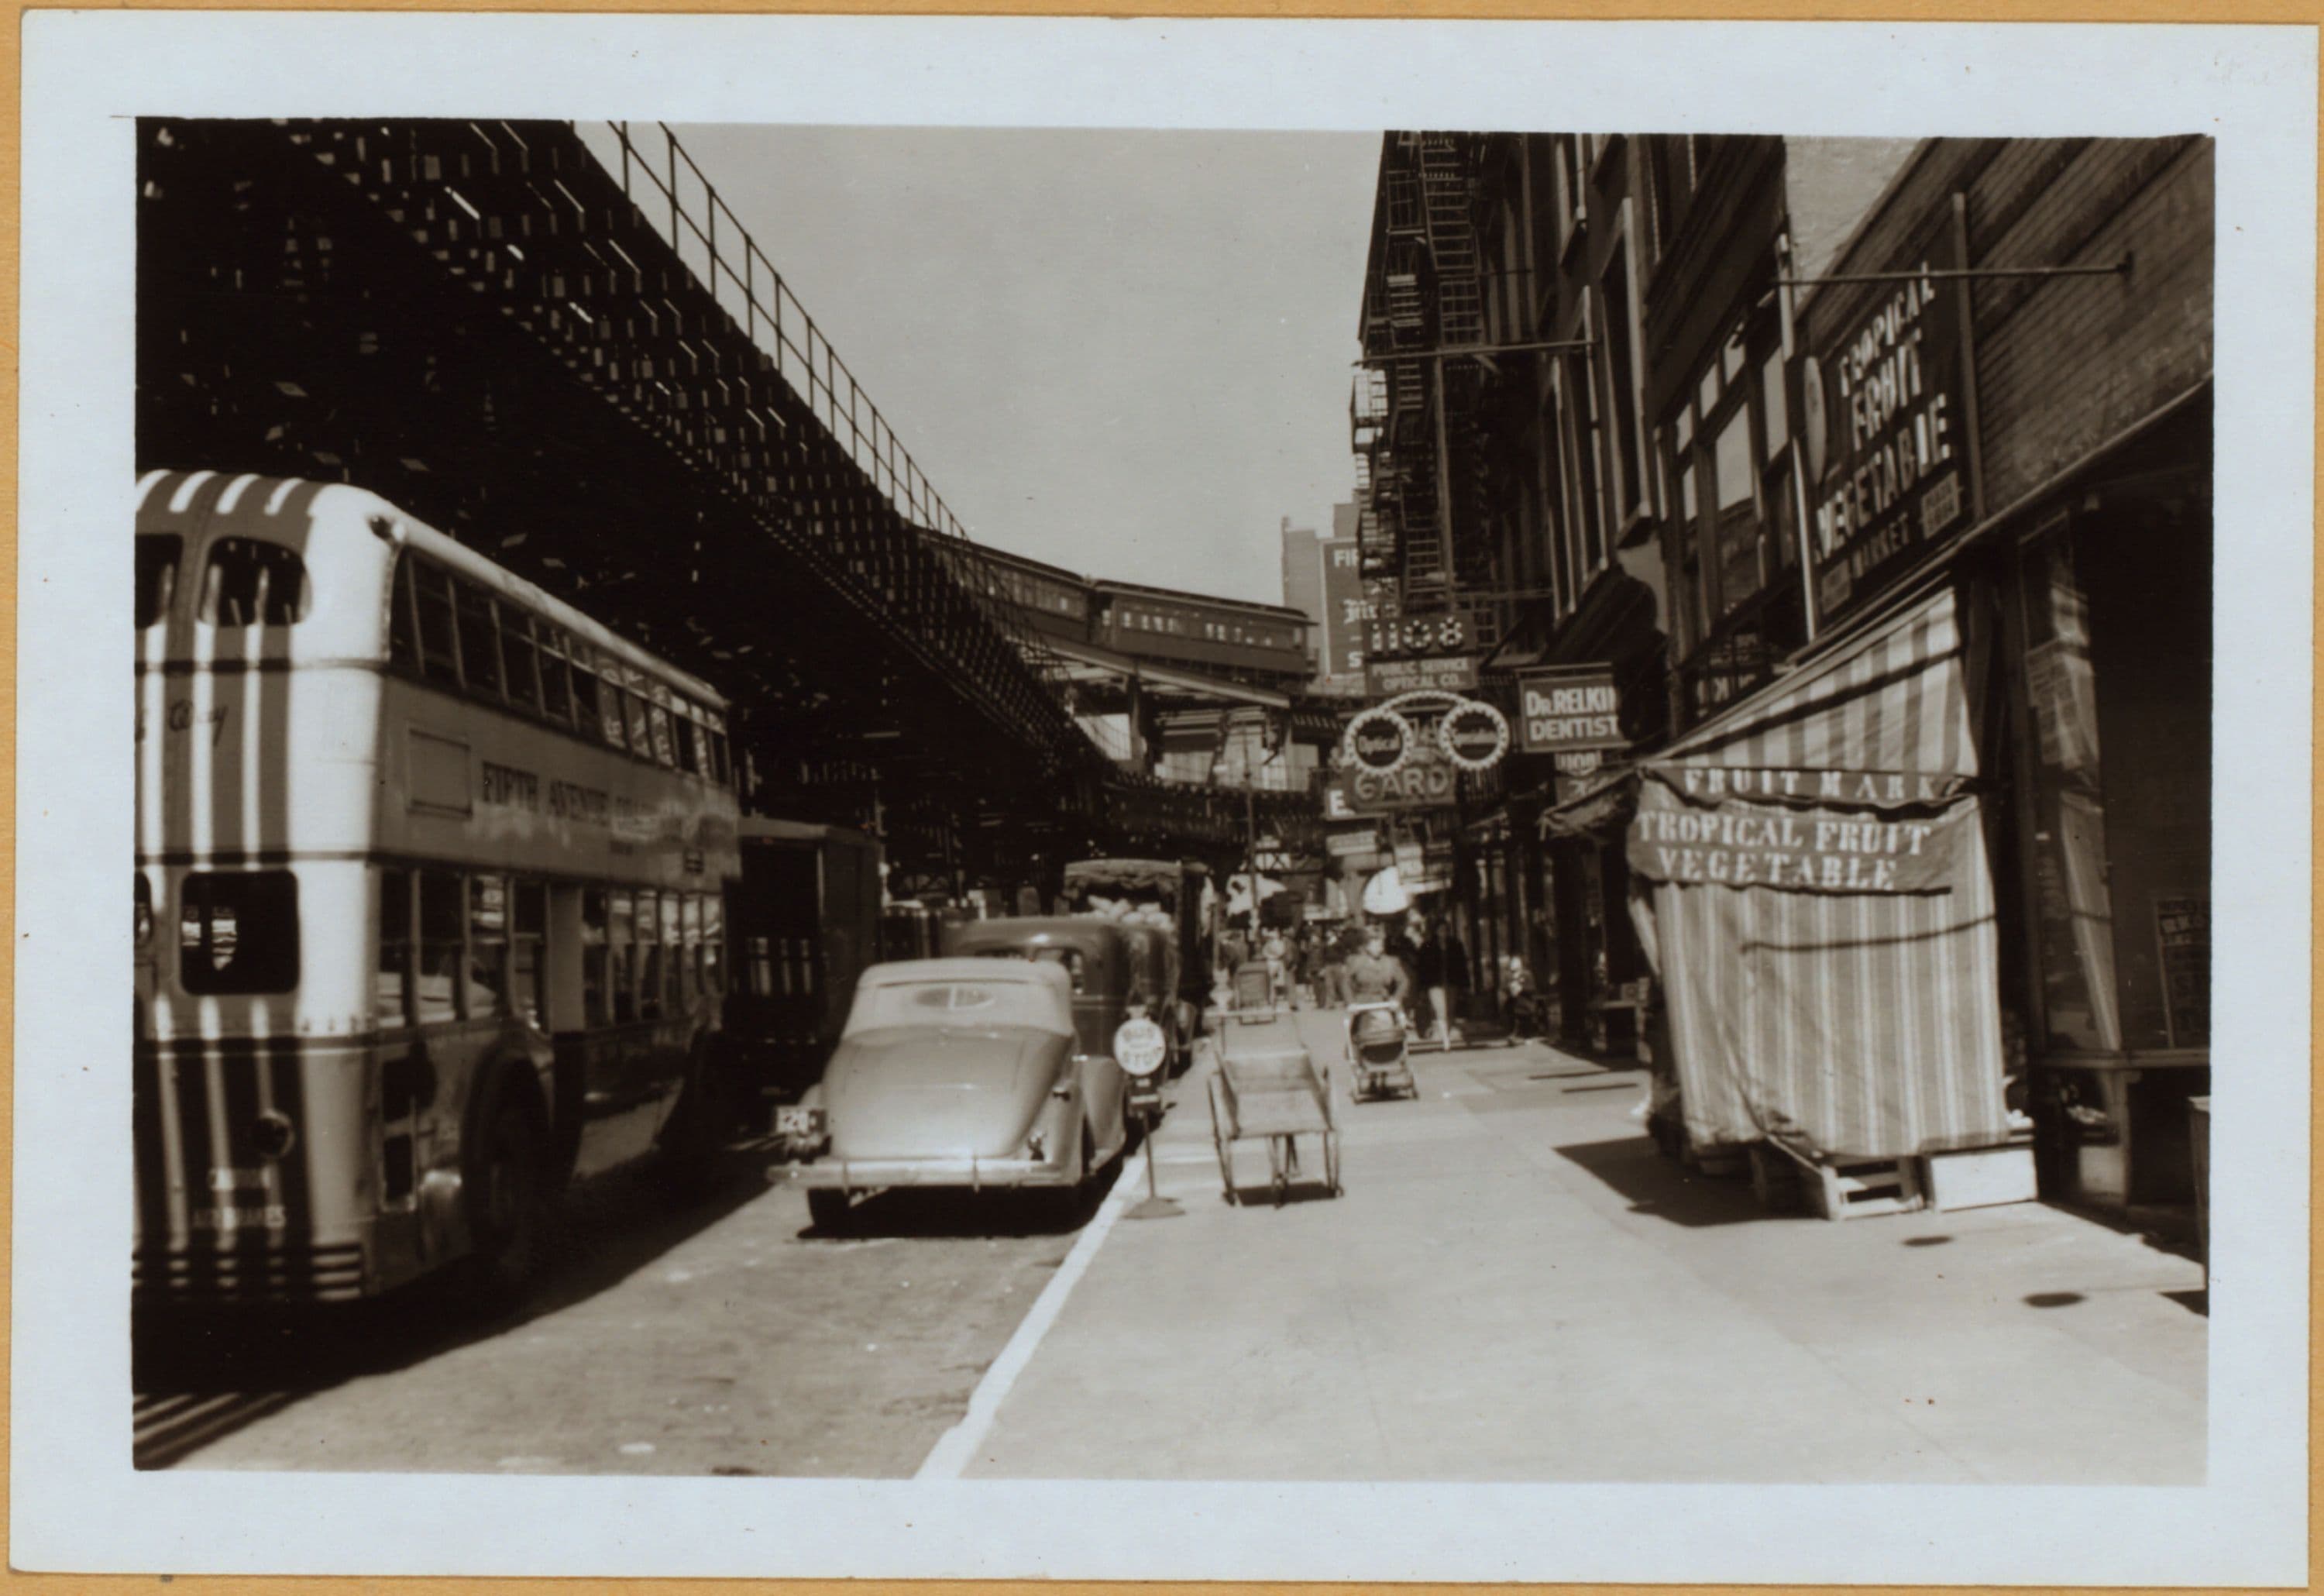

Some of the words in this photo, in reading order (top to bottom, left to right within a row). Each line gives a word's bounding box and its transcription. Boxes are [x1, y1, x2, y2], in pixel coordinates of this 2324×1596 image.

[1840, 260, 1935, 397] TROPICAL
[1851, 326, 1923, 452] FRUIT
[1815, 393, 1951, 560] VEGETABLE
[1382, 674, 1436, 691] OPTICAL
[1529, 714, 1618, 741] DENTIST
[1683, 769, 1799, 795] FRUIT
[1638, 811, 1803, 848] TROPICAL
[1815, 821, 1931, 855] FRUIT
[1657, 848, 1898, 890] VEGETABLE
